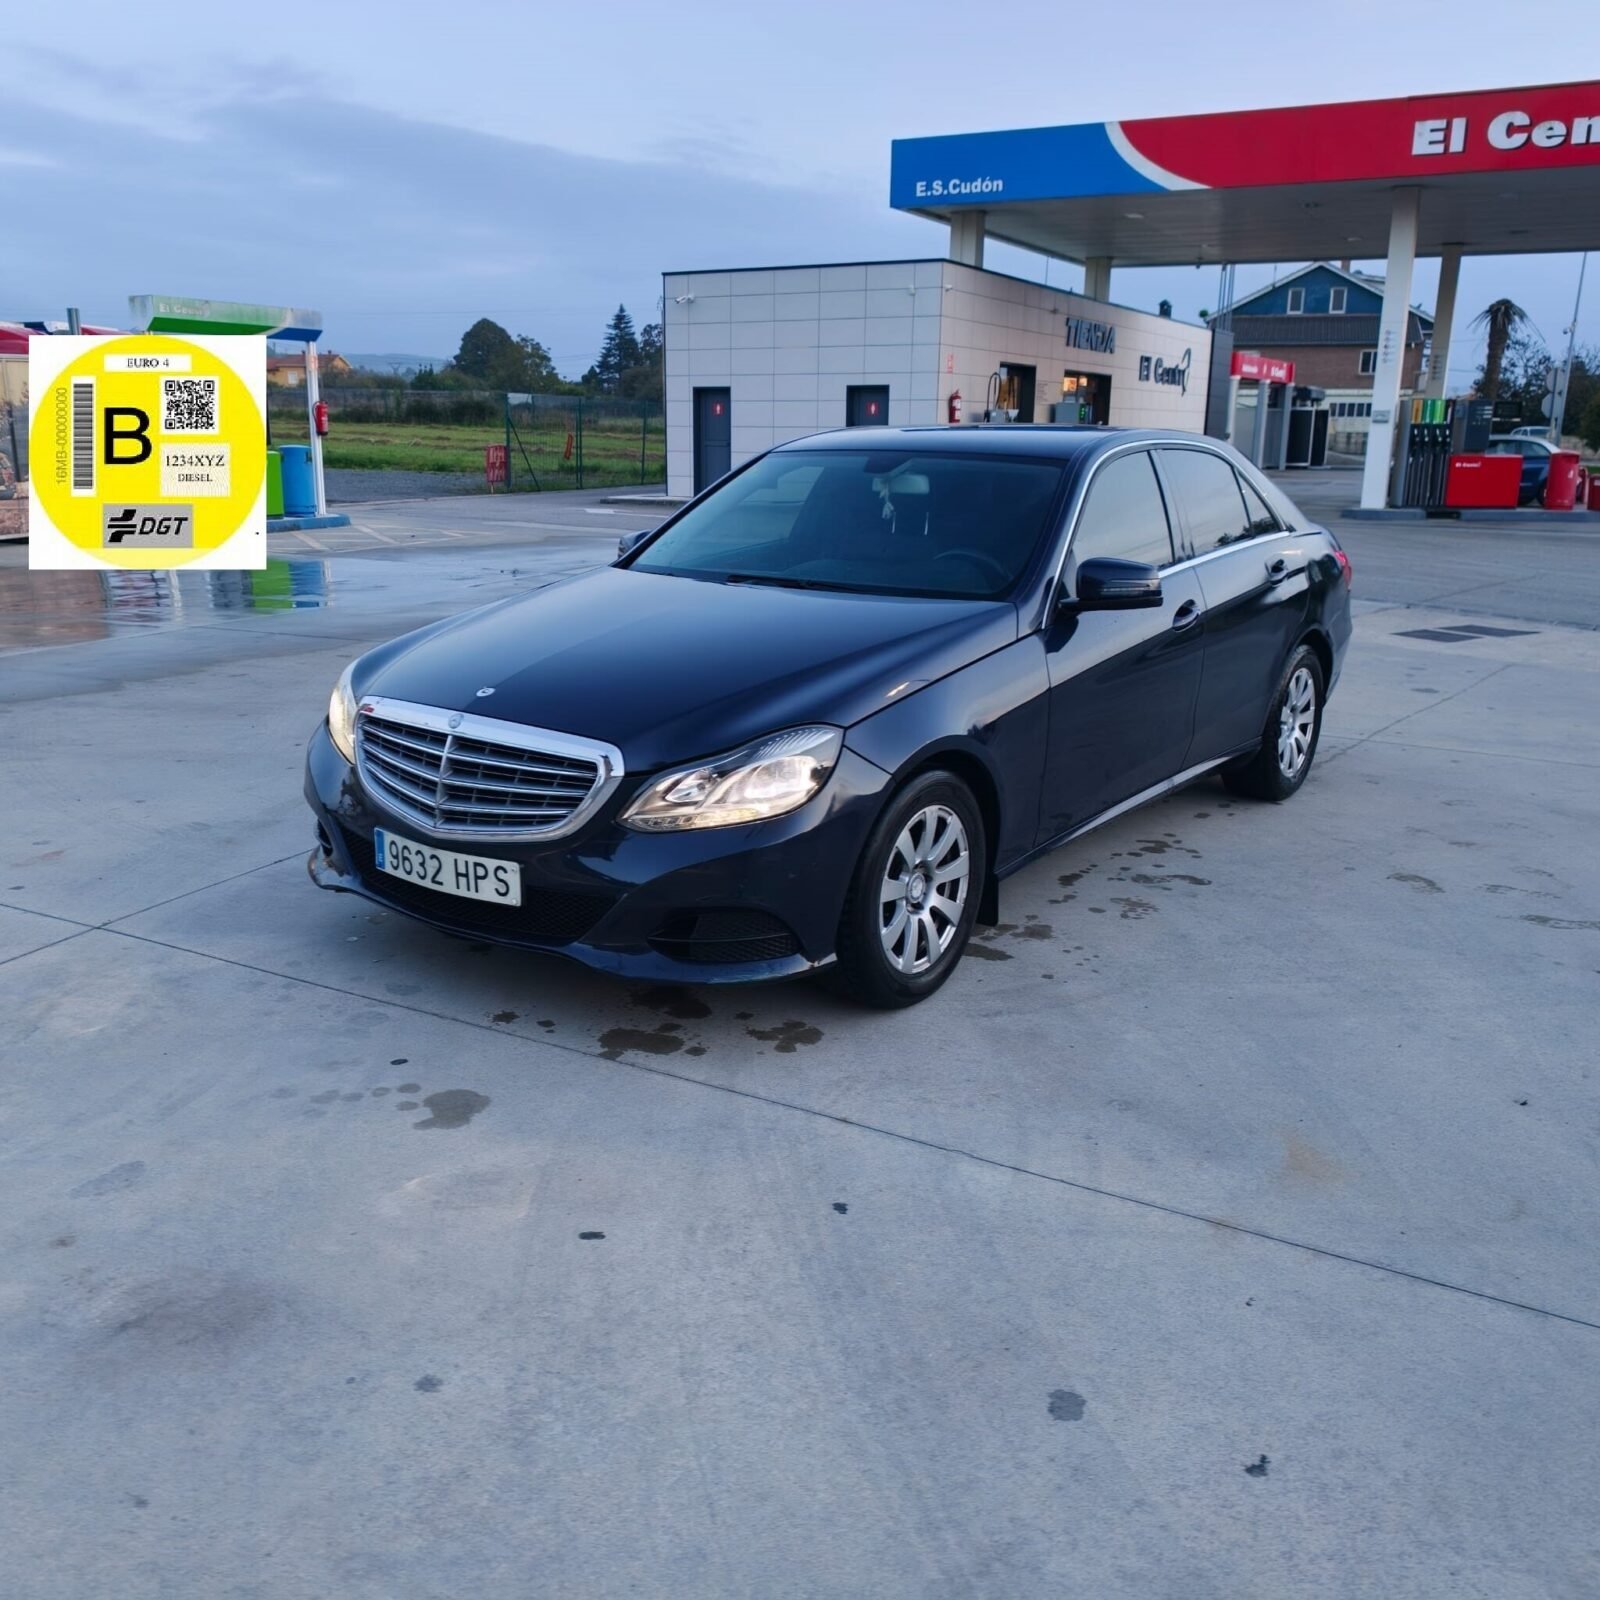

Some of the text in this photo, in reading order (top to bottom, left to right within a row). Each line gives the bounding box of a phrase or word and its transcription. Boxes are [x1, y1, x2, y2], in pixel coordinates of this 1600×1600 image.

[1411, 117, 1467, 156] El
[916, 176, 1004, 197] E.S.Cudón
[1066, 317, 1117, 354] TIENDA
[389, 840, 510, 897] 9632 HPS
